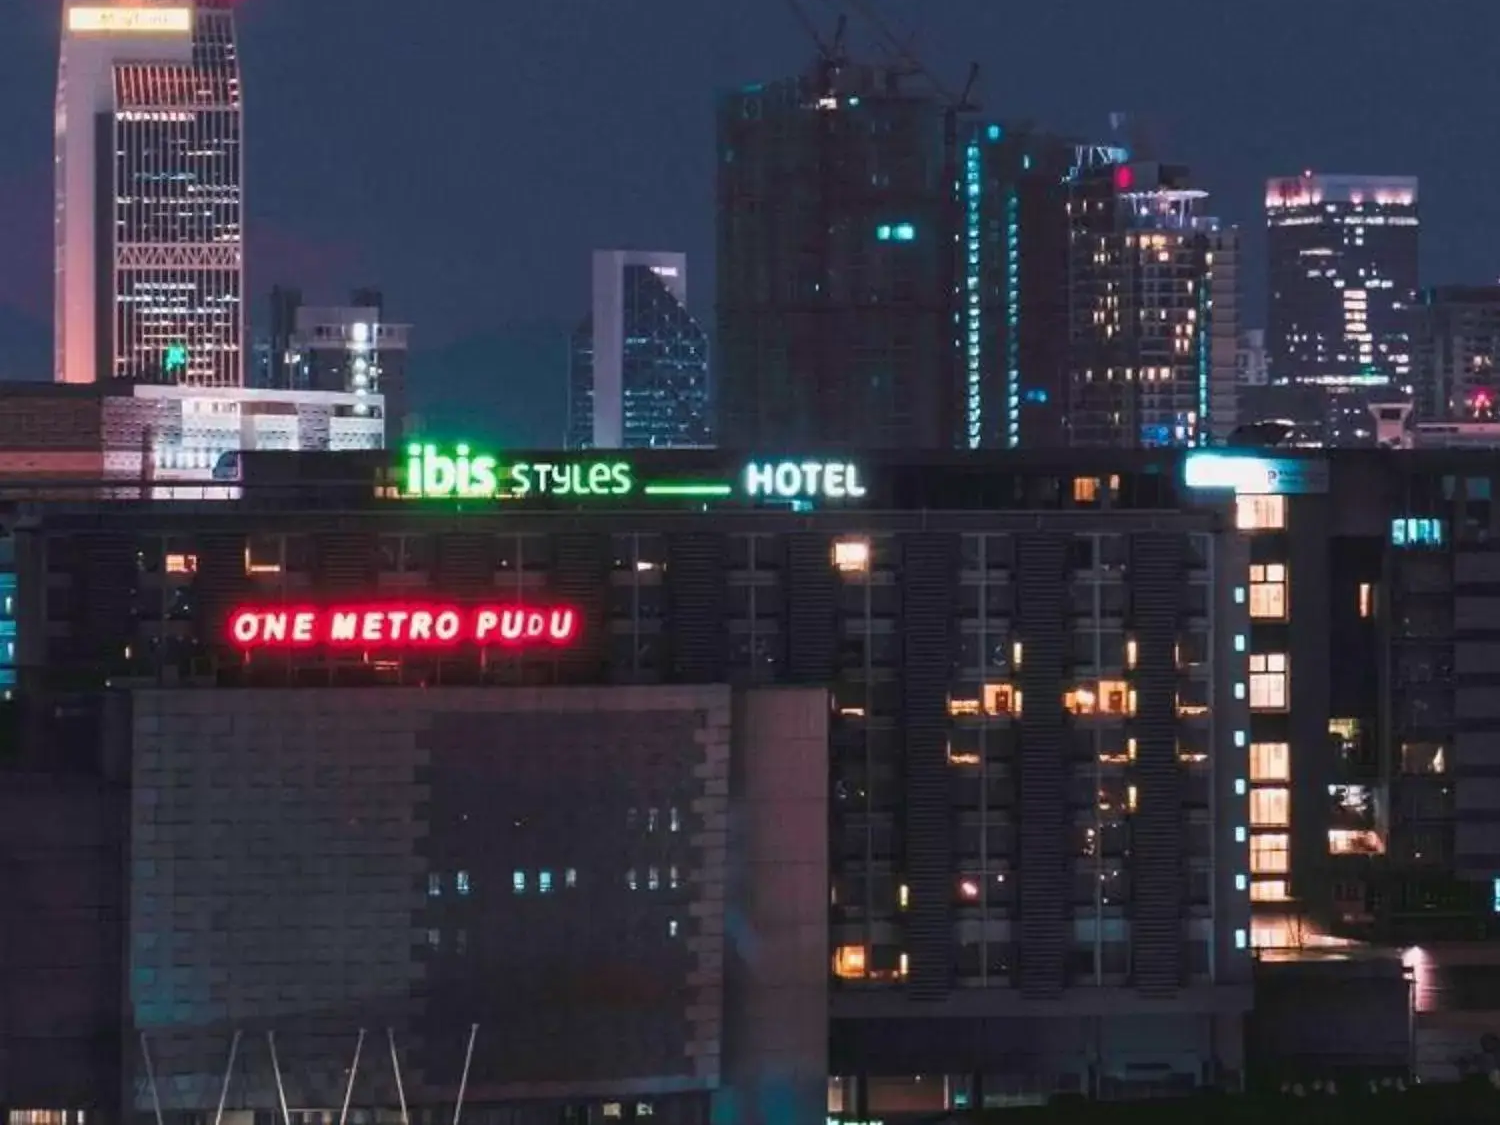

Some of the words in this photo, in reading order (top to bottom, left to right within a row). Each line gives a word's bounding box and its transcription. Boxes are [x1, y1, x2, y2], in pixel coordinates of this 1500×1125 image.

[405, 442, 499, 494] ibis
[748, 461, 867, 497] HOTEL
[233, 613, 315, 642] ONE
[331, 611, 460, 641] METRO
[475, 609, 574, 639] PUDU
